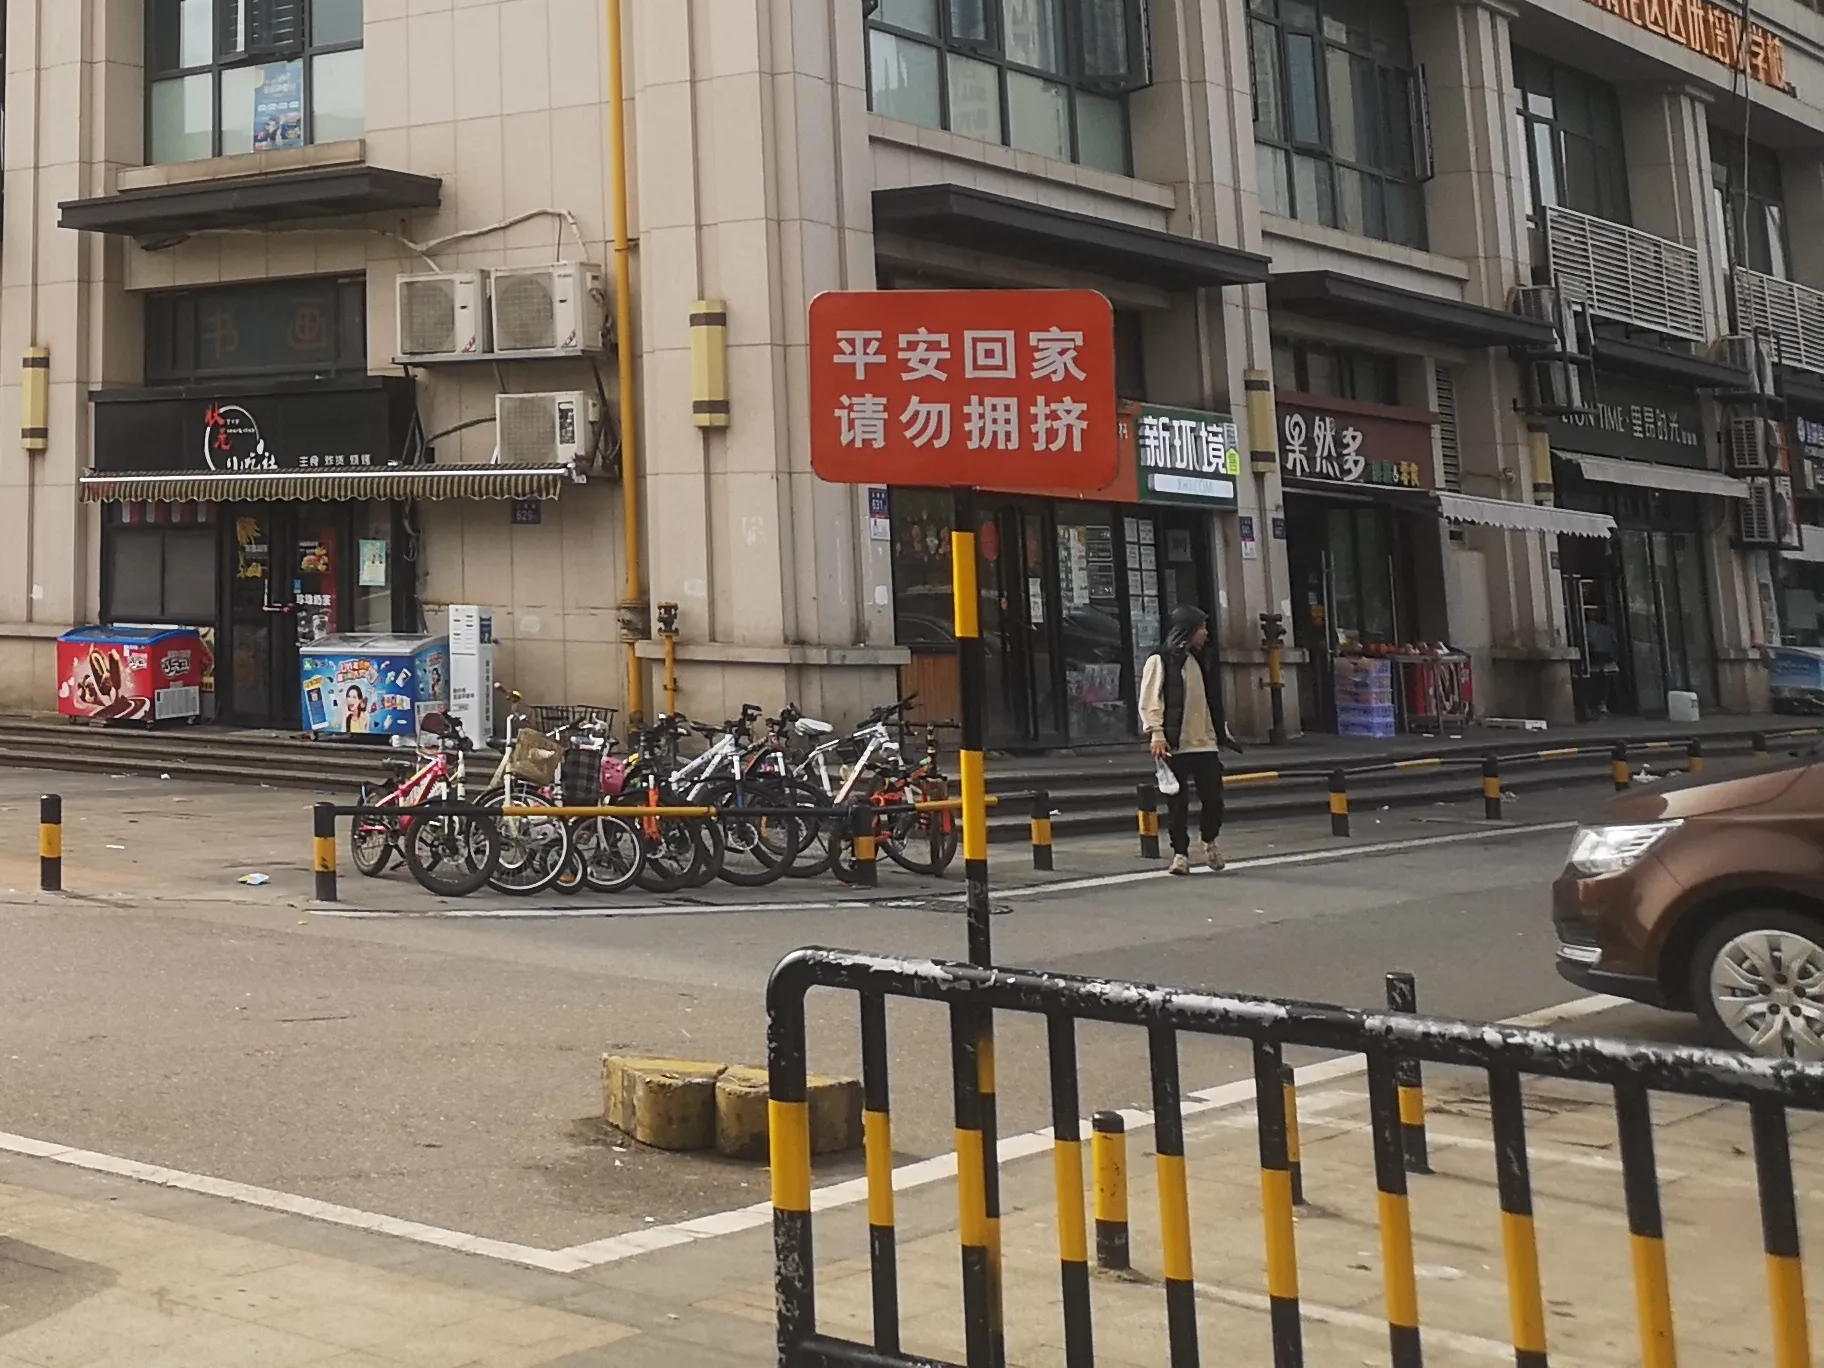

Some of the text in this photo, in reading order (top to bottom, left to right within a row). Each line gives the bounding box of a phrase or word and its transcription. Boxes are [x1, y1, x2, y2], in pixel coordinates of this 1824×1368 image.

[832, 326, 1088, 383] 平安回家
[833, 393, 1089, 452] 请勿拥挤
[1140, 415, 1227, 474] 新环境
[1597, 403, 1625, 432] TIME
[1284, 413, 1366, 482] 果然多
